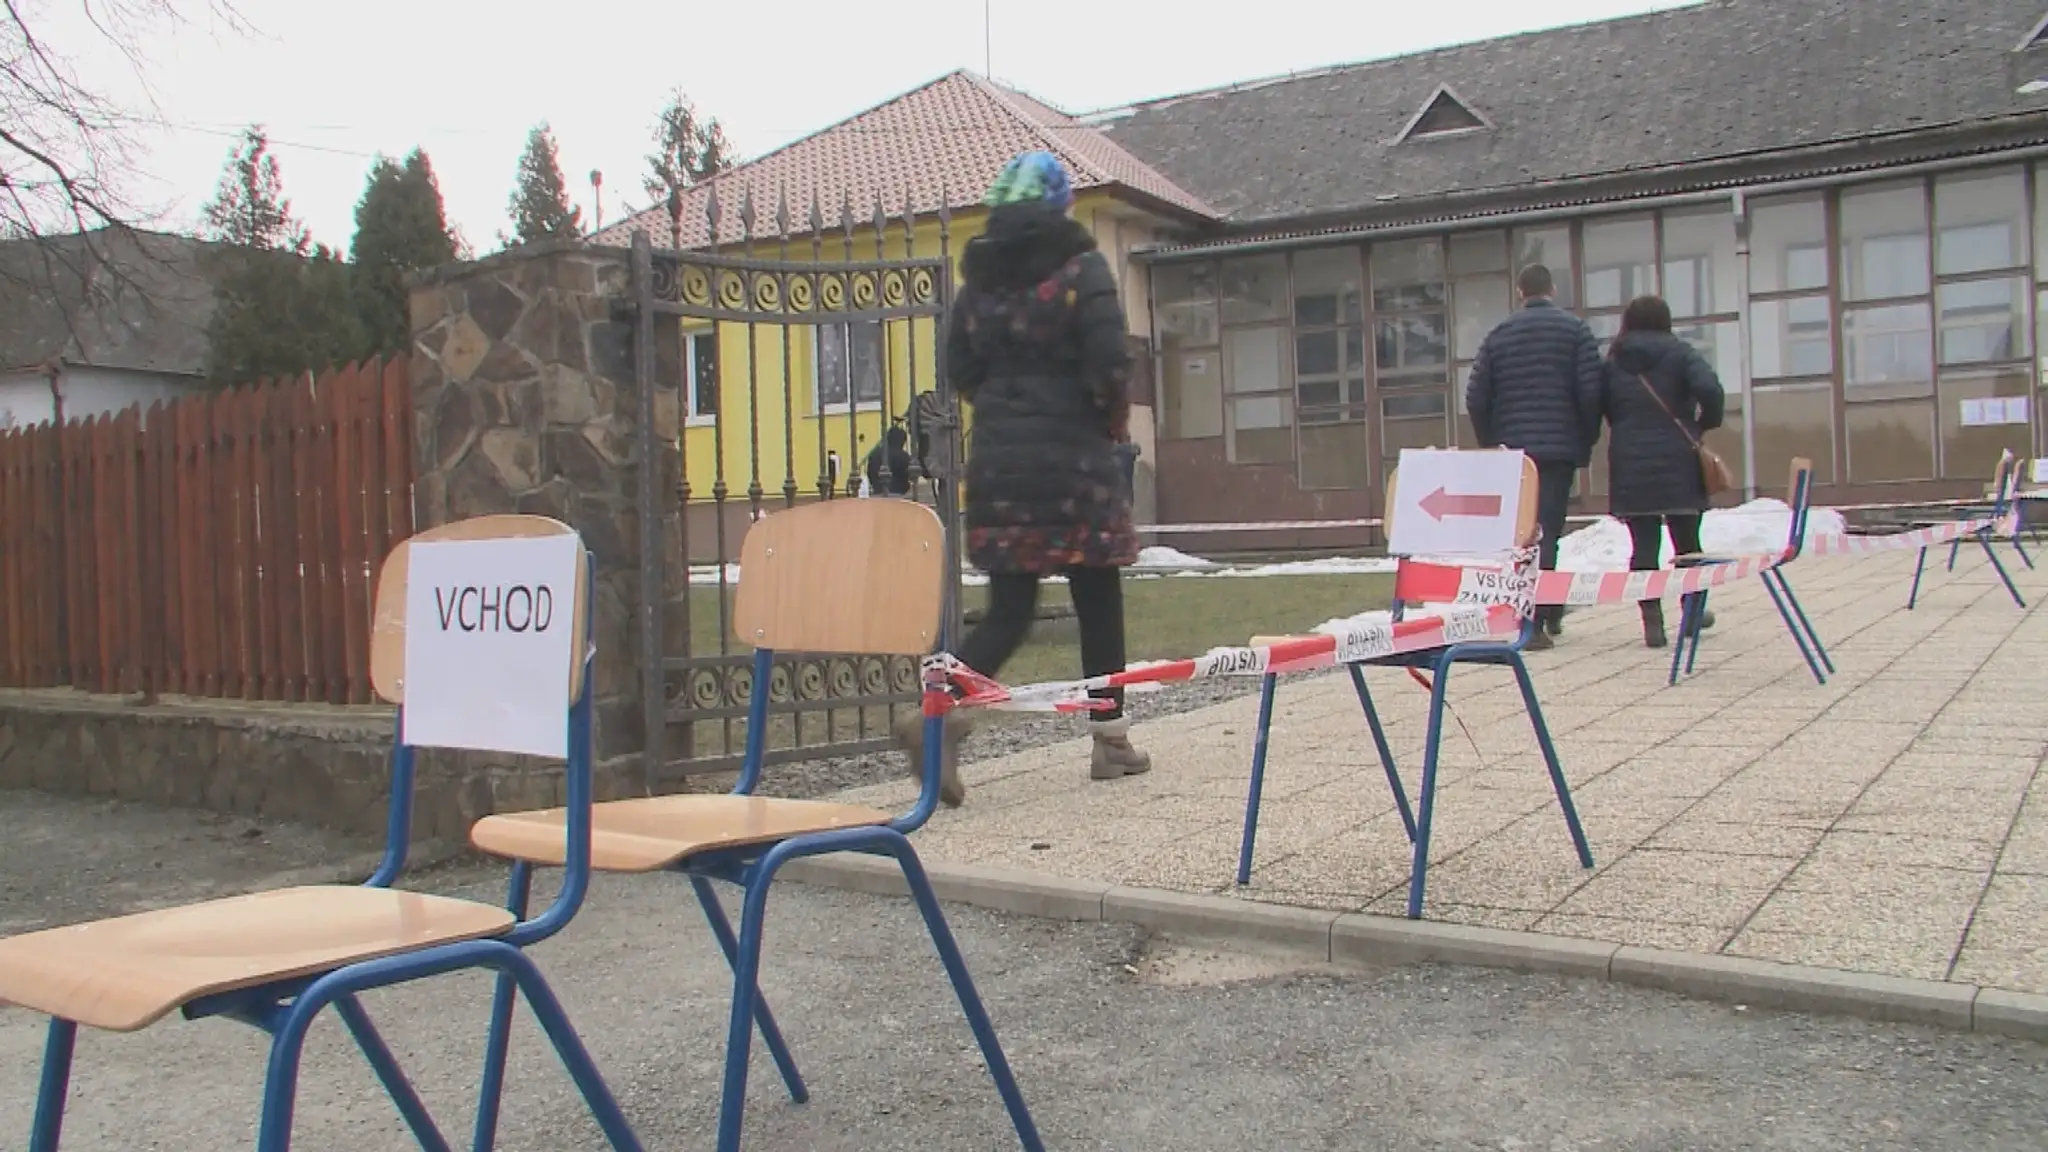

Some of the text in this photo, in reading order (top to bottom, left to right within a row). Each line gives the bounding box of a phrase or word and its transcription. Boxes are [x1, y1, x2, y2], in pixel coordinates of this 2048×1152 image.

[1476, 571, 1528, 592] VSTUP
[435, 584, 553, 632] VCHOD
[1207, 651, 1257, 676] VSTUP
